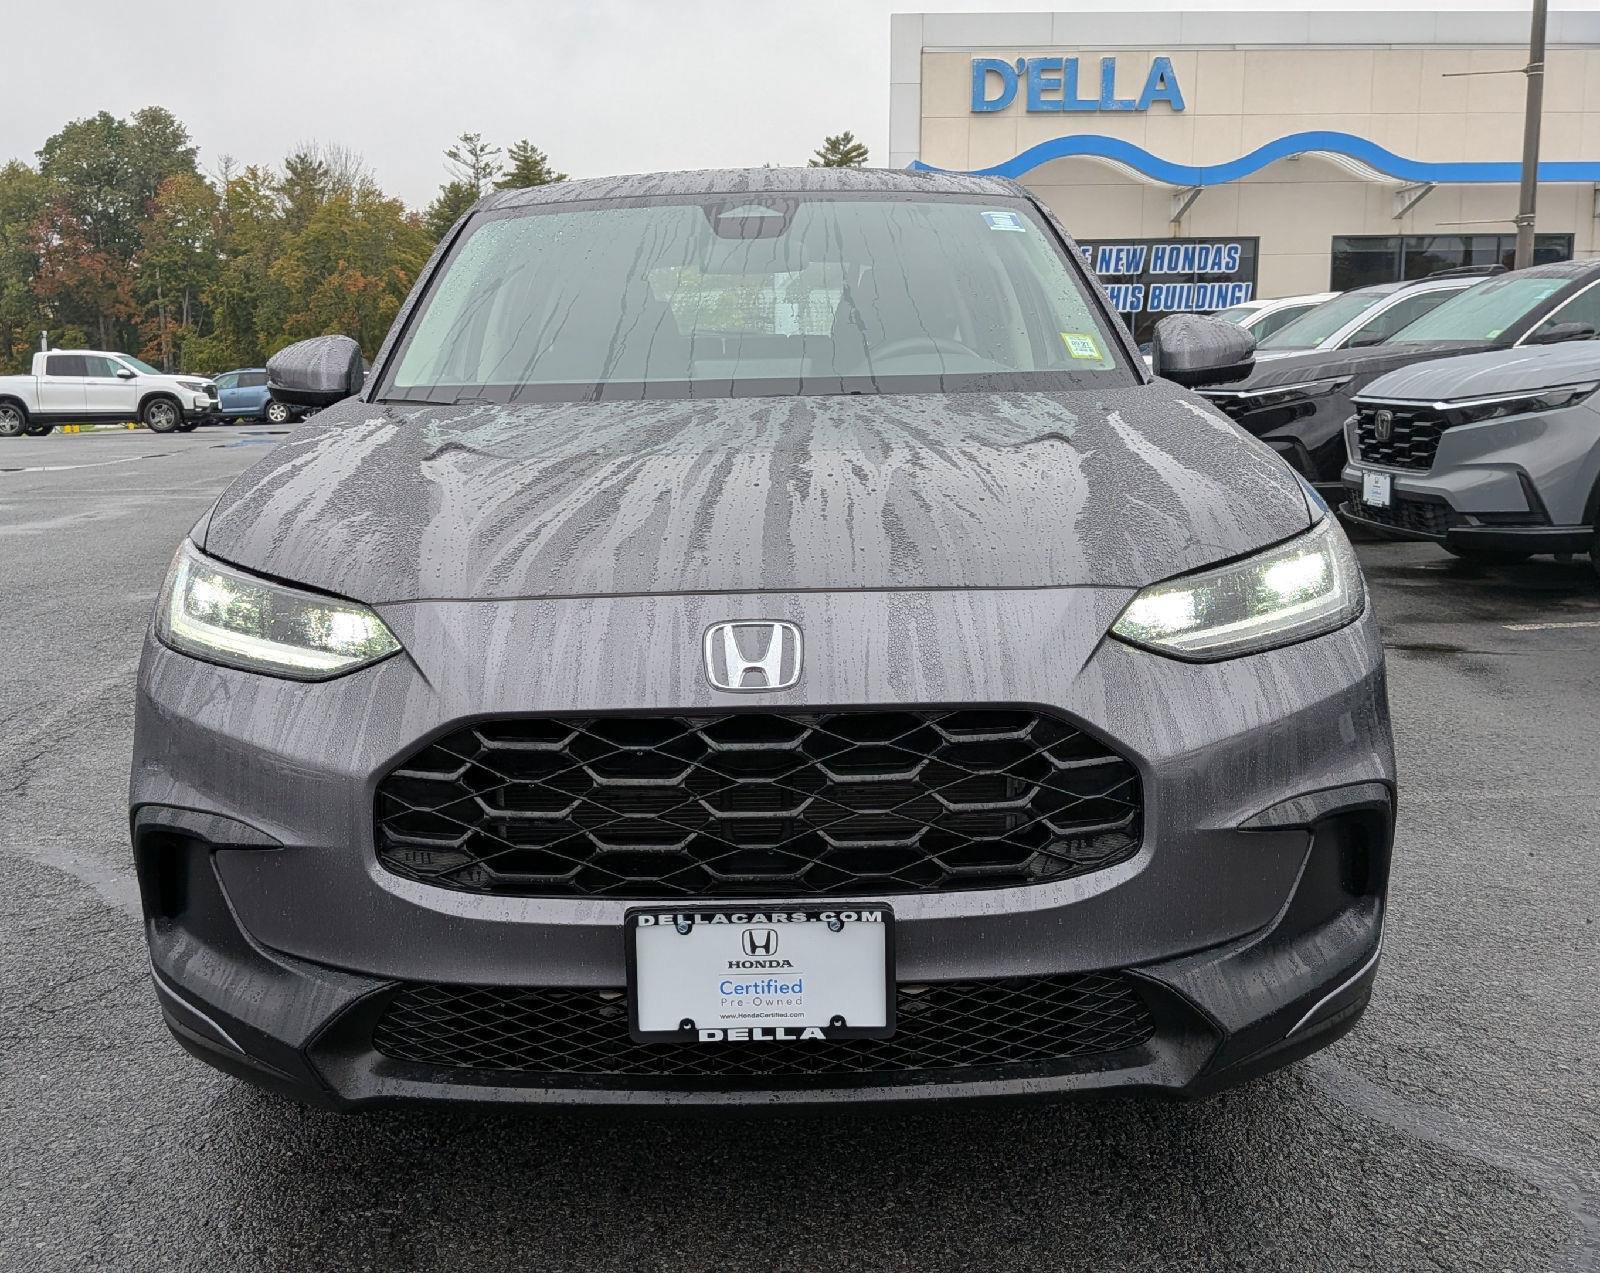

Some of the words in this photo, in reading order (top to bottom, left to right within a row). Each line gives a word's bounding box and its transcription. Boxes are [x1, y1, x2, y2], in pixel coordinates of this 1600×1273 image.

[970, 57, 1186, 112] D'ELLA
[1096, 245, 1147, 275] NEW
[1150, 244, 1242, 274] HONDAS
[1102, 284, 1145, 312] HIS
[1147, 282, 1252, 311] BUILDING!
[638, 911, 882, 926] DELLACARS.COM
[727, 959, 794, 969] HONDA
[720, 978, 803, 995] Certified
[719, 1011, 805, 1019] www.HondaCertified.com
[698, 1027, 826, 1042] DELLA
